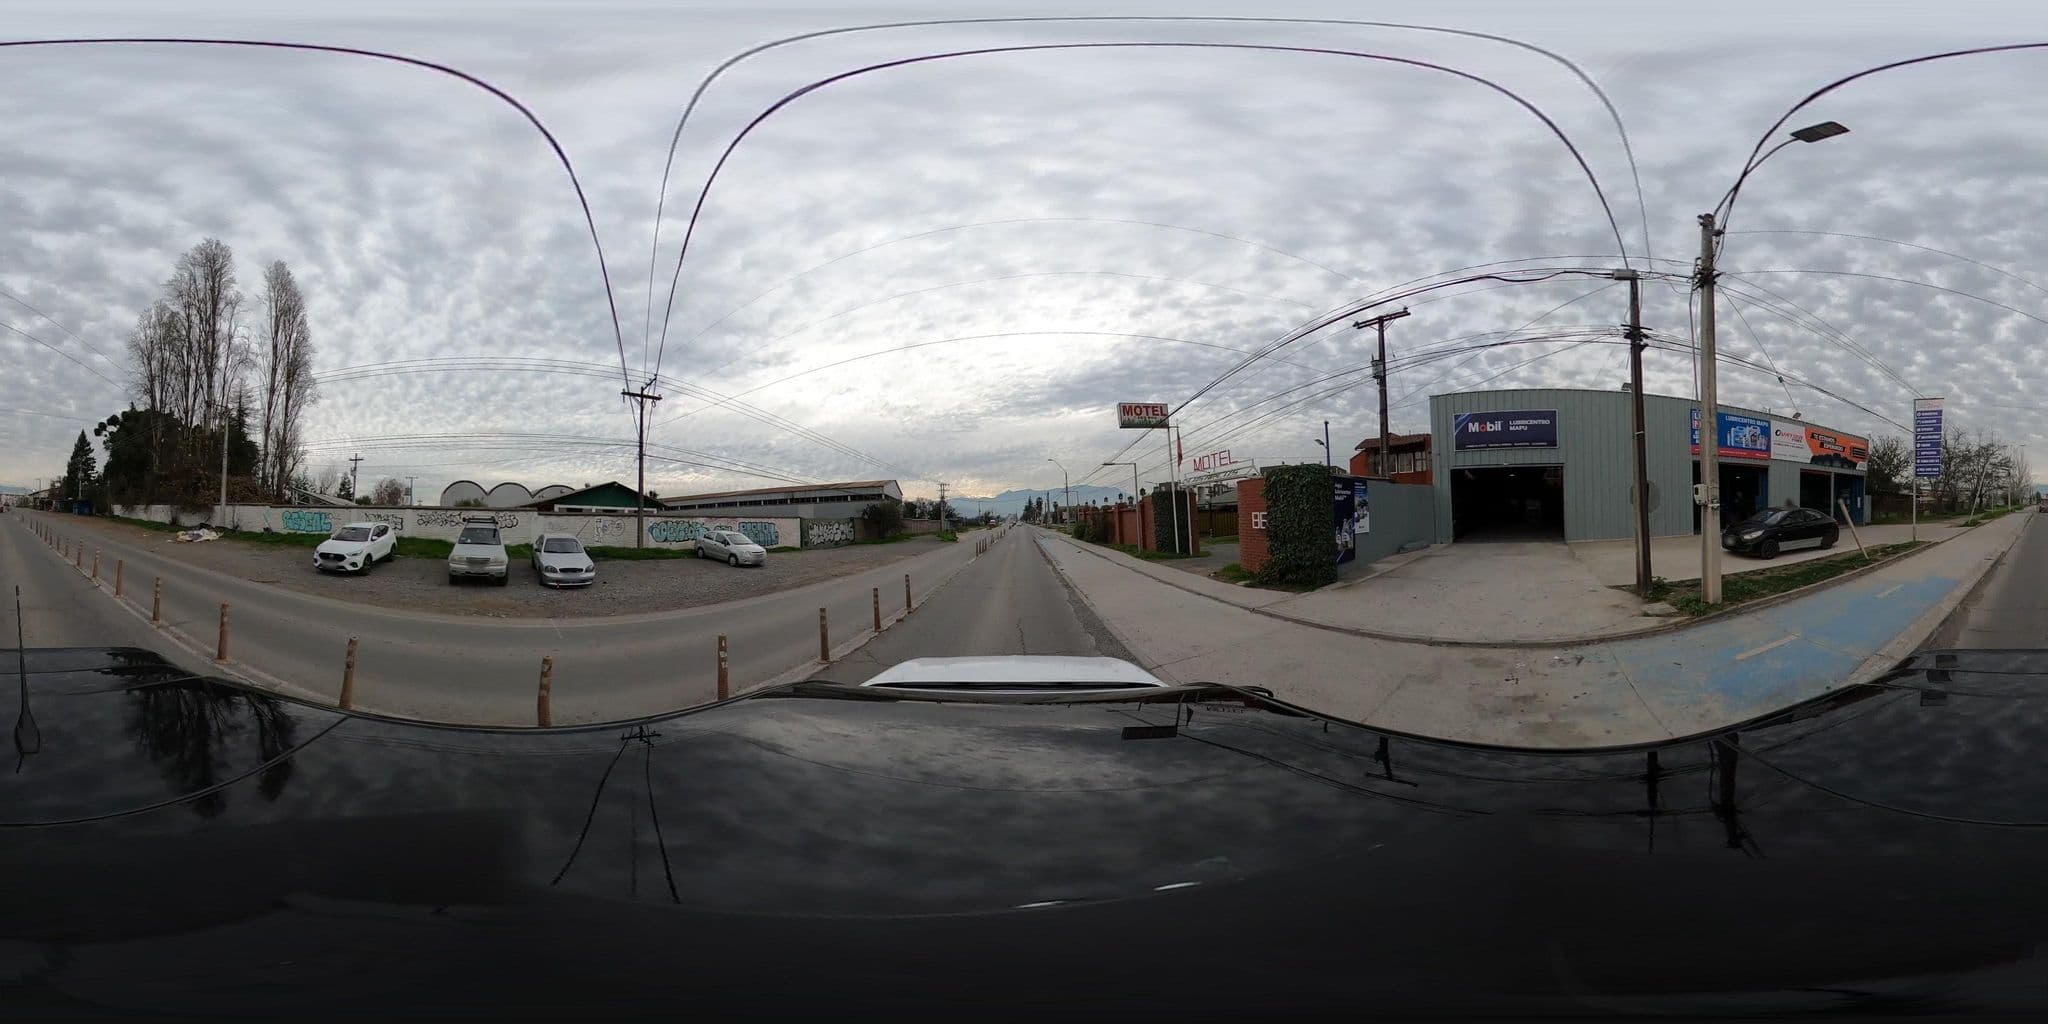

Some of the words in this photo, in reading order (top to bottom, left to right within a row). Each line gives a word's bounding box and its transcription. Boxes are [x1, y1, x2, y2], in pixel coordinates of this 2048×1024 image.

[1121, 405, 1168, 416] MOTEL
[1468, 421, 1502, 432] Mobil
[1193, 449, 1239, 471] MOTEL
